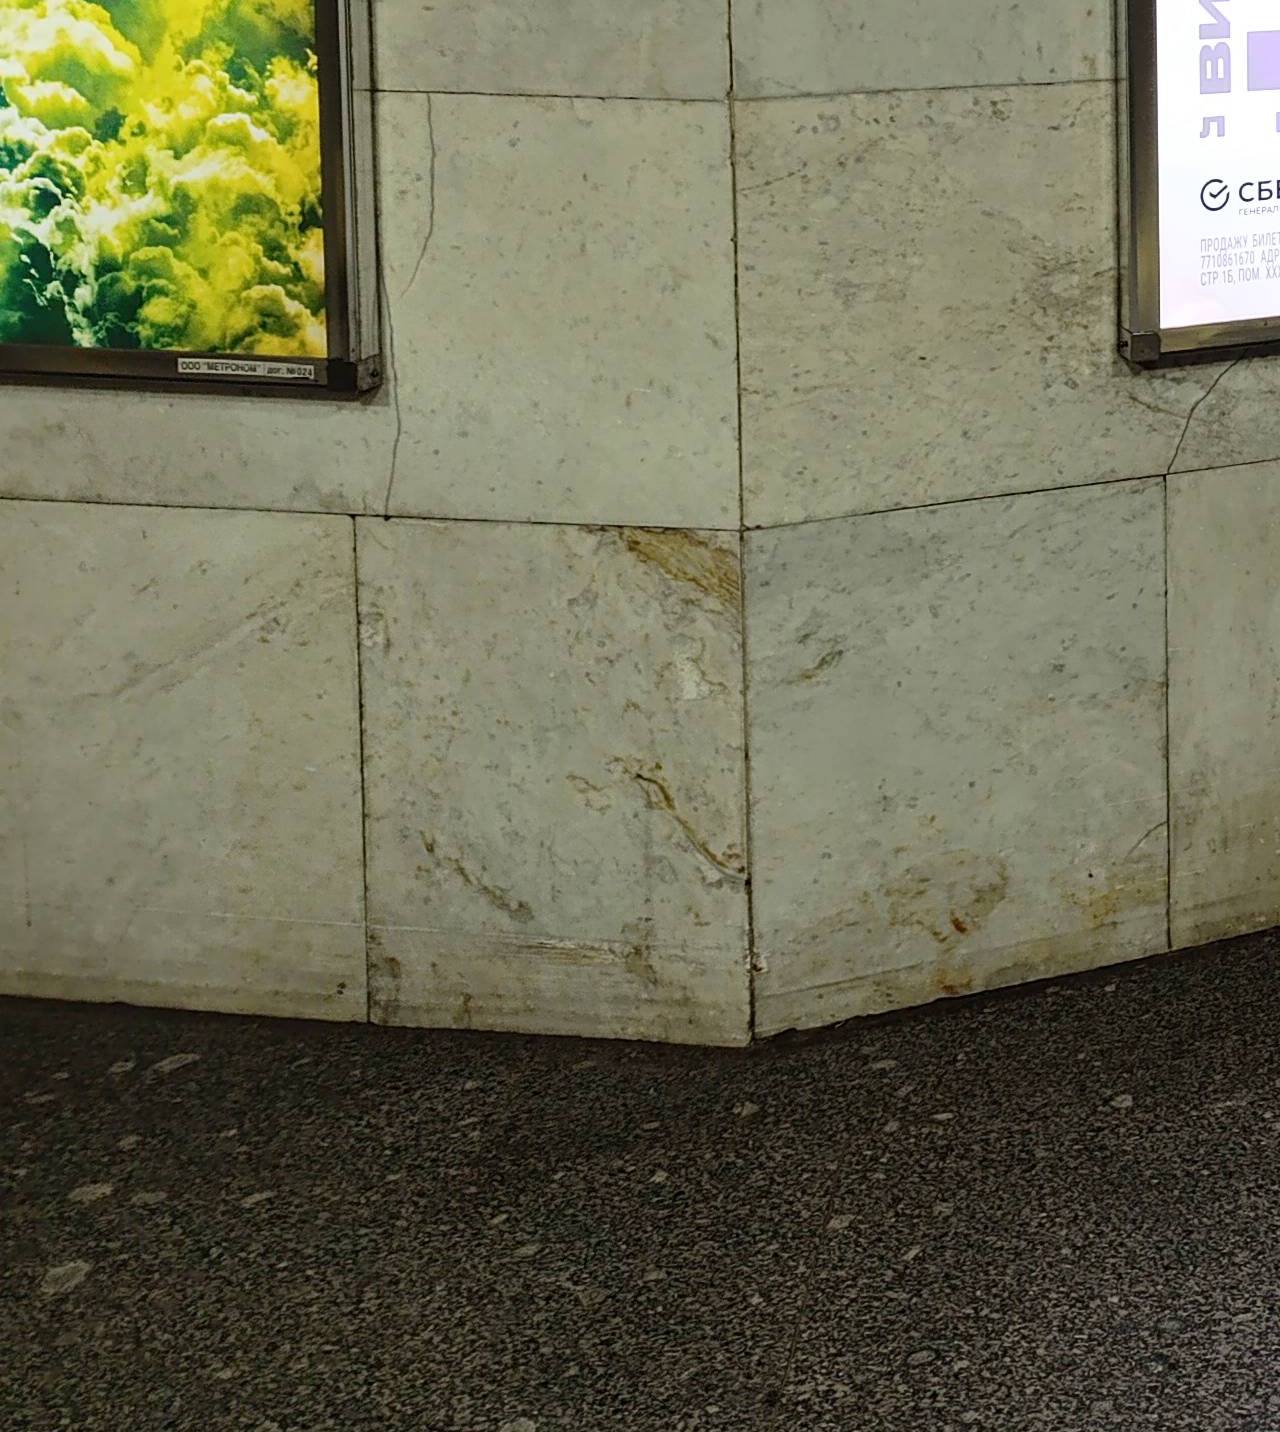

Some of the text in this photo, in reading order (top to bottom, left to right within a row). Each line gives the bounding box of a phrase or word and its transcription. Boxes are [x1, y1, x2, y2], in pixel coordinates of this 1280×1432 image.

[1200, 235, 1248, 253] ПРОДАЖУ
[1201, 251, 1255, 269] 7710861670
[181, 361, 201, 370] ООО
